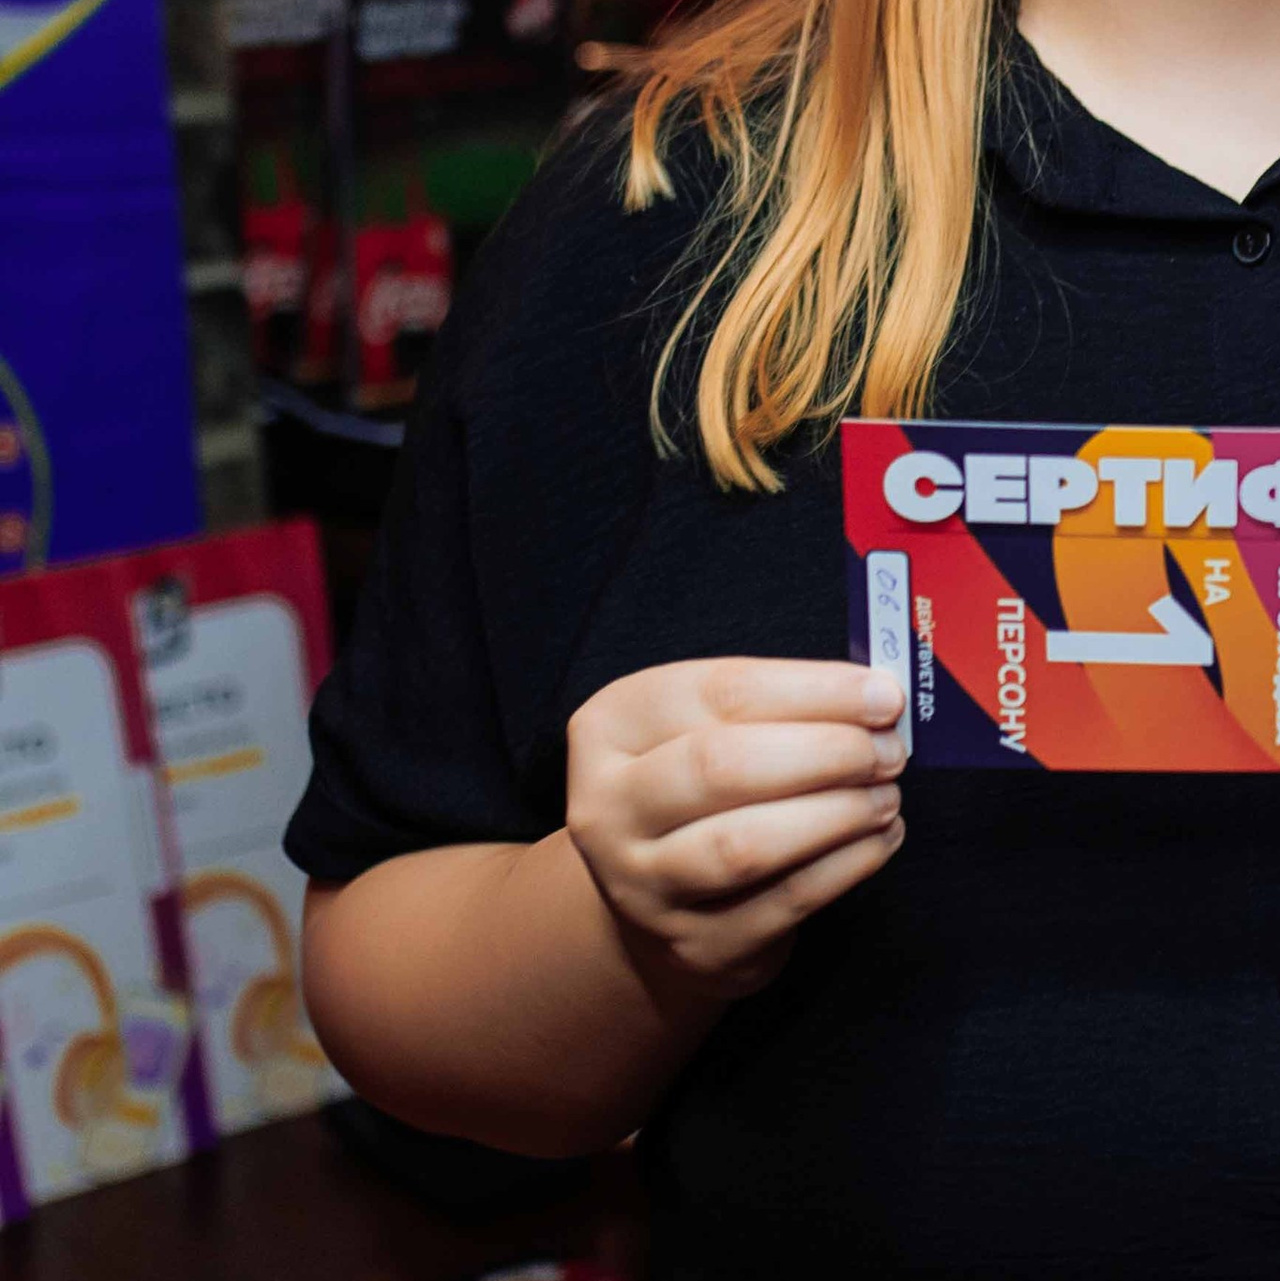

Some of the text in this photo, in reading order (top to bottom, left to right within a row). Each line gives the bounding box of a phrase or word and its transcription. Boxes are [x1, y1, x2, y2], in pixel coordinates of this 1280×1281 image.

[1203, 559, 1231, 606] НА
[915, 596, 935, 690] ДЕЙСТВУЕТ
[1046, 594, 1214, 666] 1
[997, 598, 1026, 754] ПЕРСОНУ
